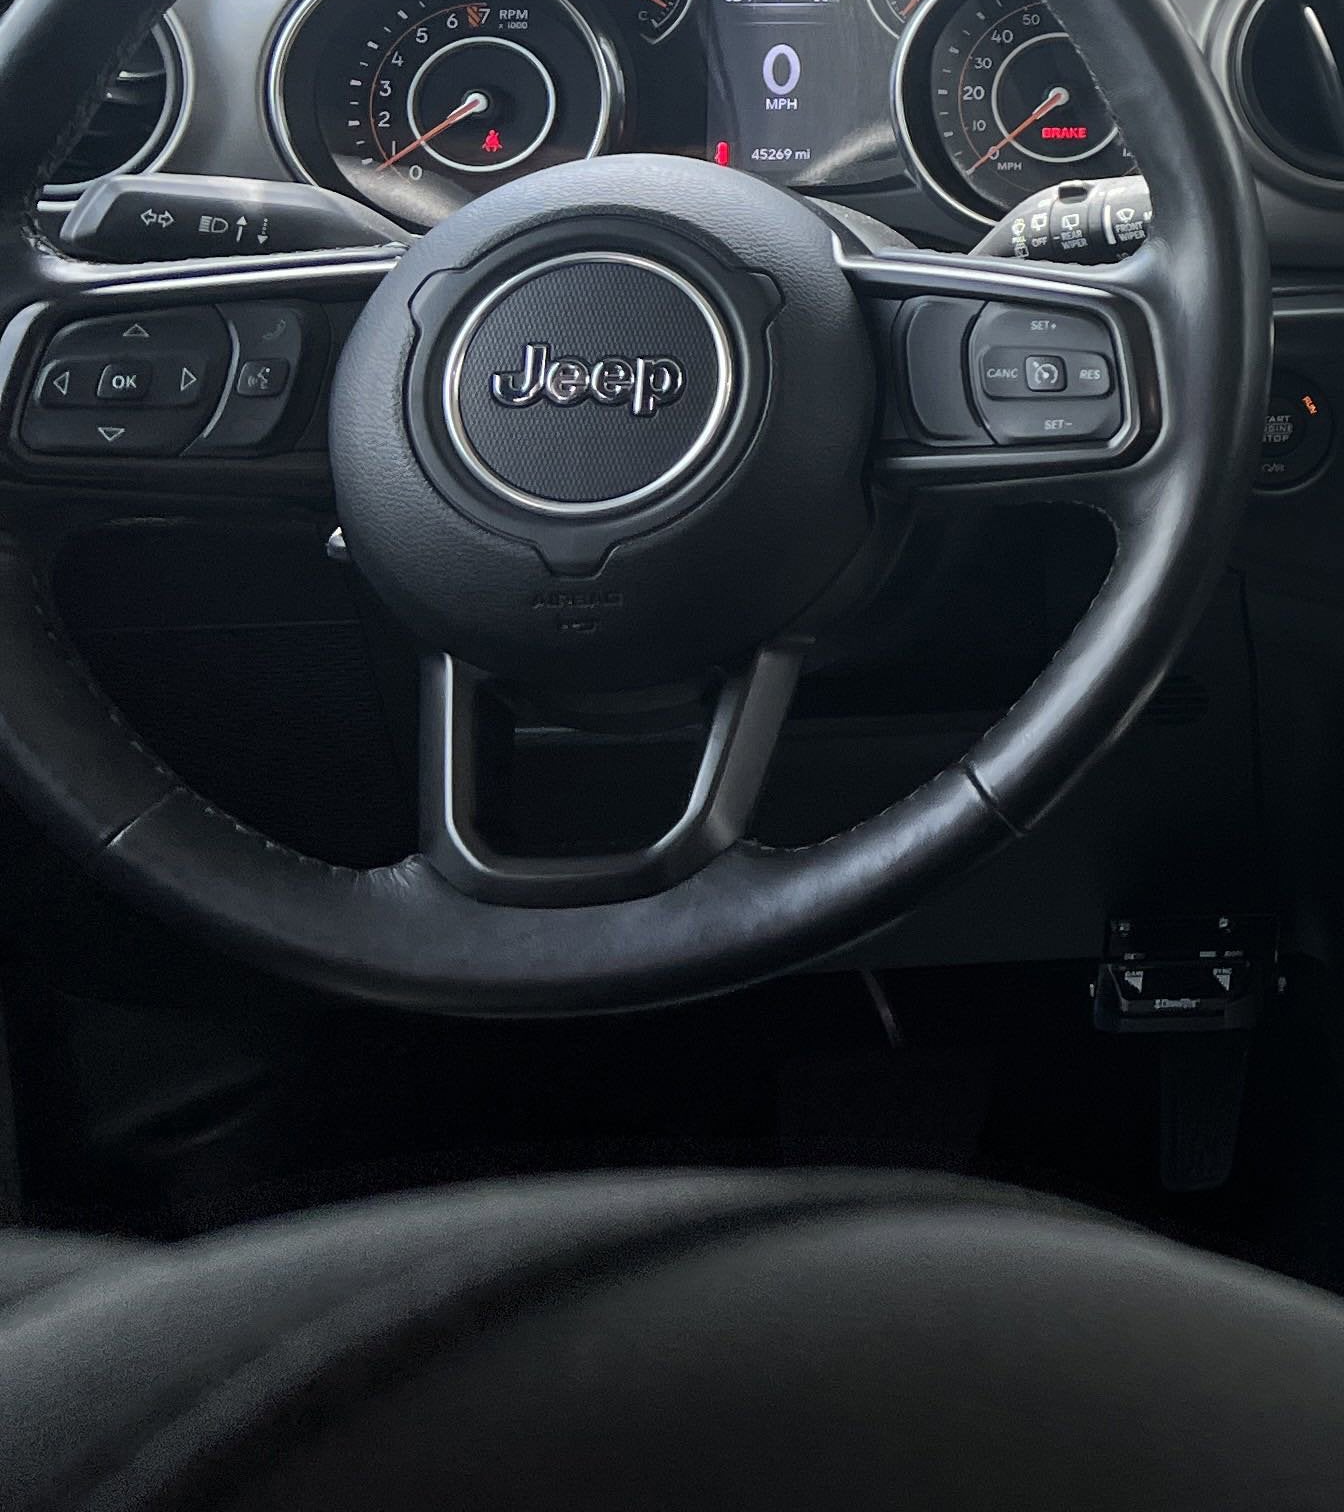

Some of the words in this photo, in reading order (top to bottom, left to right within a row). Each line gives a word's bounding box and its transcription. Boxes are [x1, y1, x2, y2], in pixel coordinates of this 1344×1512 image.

[479, 8, 491, 25] 7
[499, 9, 528, 20] RPM
[1022, 14, 1040, 25] 50
[446, 13, 458, 29] 6
[415, 28, 428, 43] 5
[991, 30, 1014, 44] 40
[392, 51, 404, 66] 4
[974, 57, 992, 69] 30
[763, 43, 801, 96] 0
[379, 80, 392, 97] 3
[963, 86, 985, 100] 20
[765, 98, 798, 110] MPH
[378, 111, 390, 128] 2
[972, 120, 986, 131] 10
[1041, 127, 1087, 139] BRAKE
[751, 149, 793, 160] 45269
[795, 149, 811, 160] mi
[409, 164, 422, 180] 0
[997, 162, 1022, 171] MPH
[1114, 221, 1143, 233] FRONT
[1060, 230, 1083, 241] REAR
[1119, 230, 1146, 242] WIPER
[1031, 236, 1048, 248] OFF
[1061, 238, 1088, 250] WIPER
[489, 341, 688, 418] Jeep
[987, 368, 1019, 378] CANC
[1080, 369, 1101, 380] RES
[111, 374, 137, 390] OK
